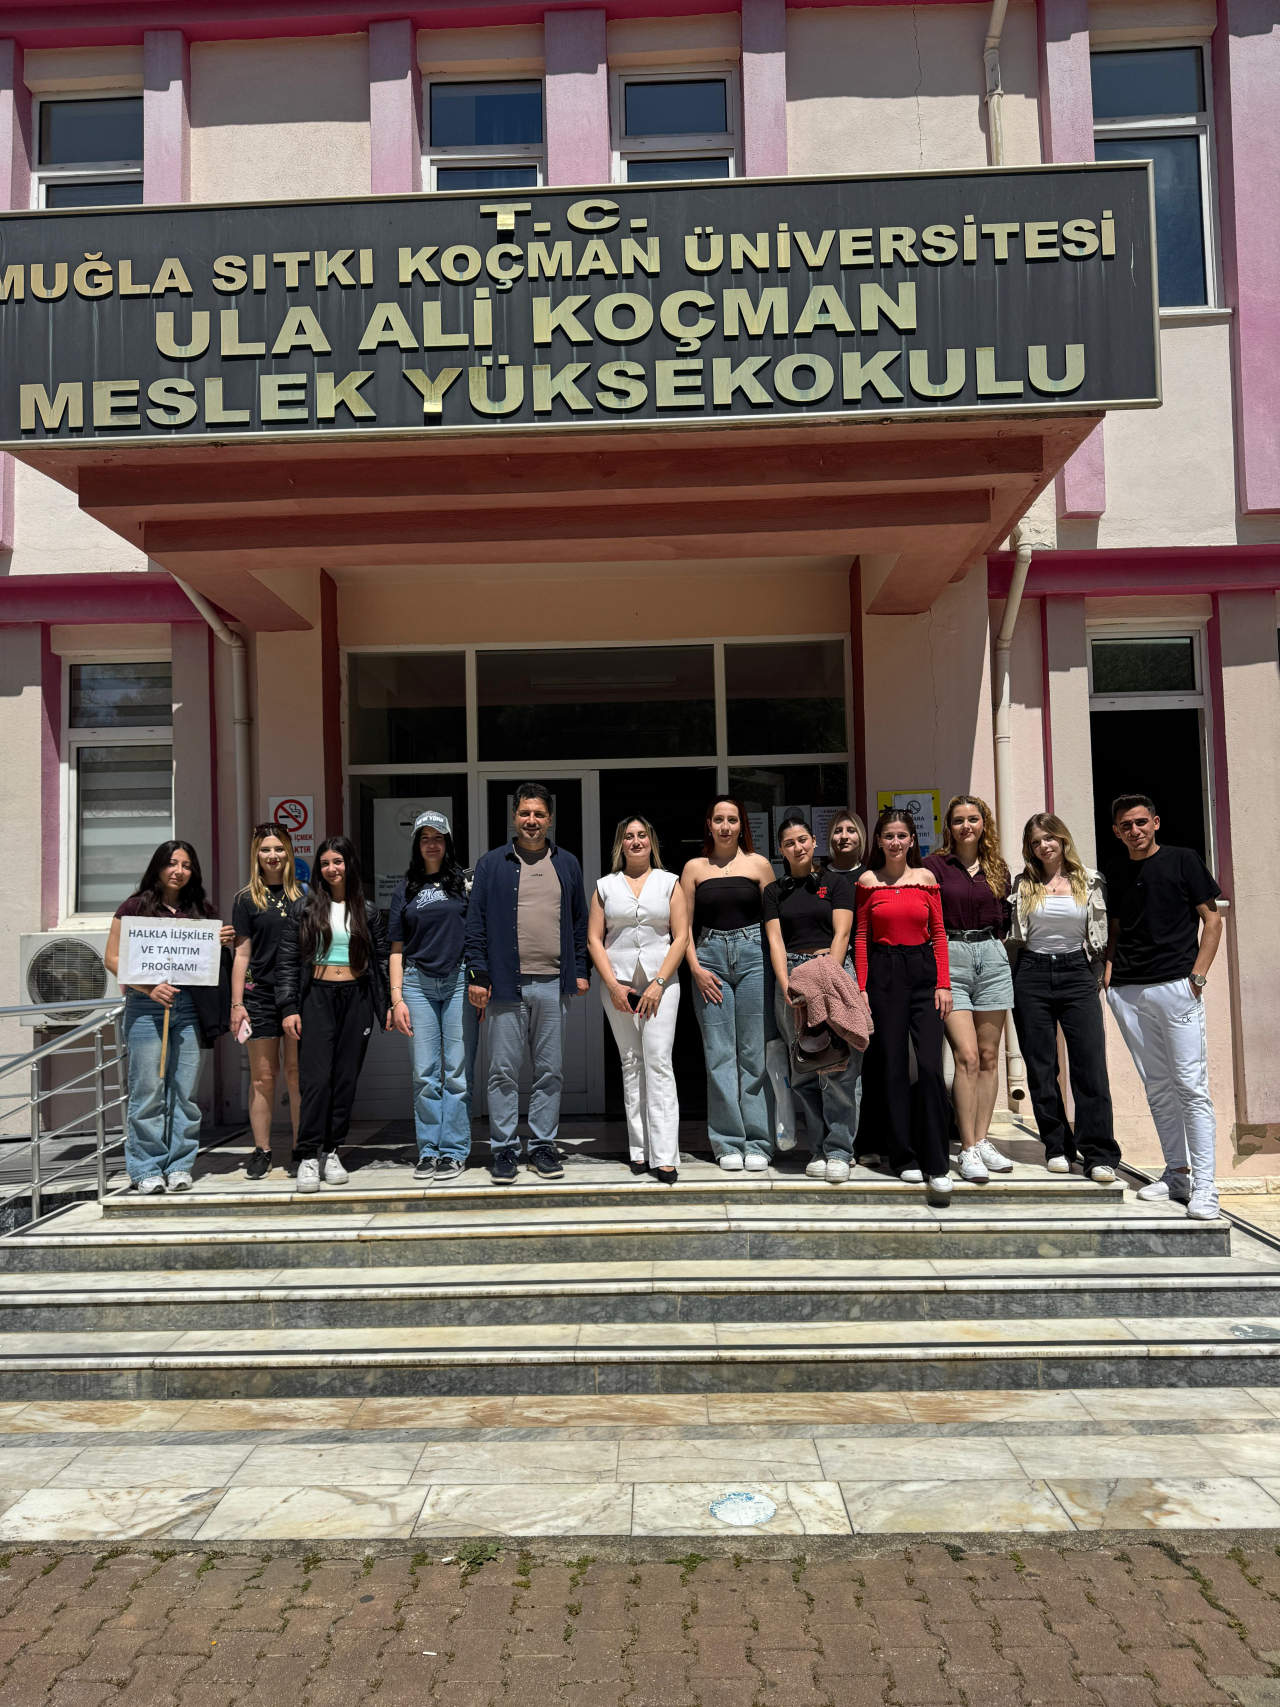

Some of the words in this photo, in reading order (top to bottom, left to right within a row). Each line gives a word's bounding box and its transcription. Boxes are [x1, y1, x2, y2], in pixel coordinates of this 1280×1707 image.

[480, 199, 648, 230] T.C.
[0, 253, 193, 299] MUĞLA
[212, 248, 374, 293] SITKI
[399, 236, 661, 290] KOÇMAN
[684, 209, 1117, 272] ÜNİVERSİTESİ
[155, 305, 333, 358] ULA
[358, 287, 493, 351] ALİ
[532, 281, 918, 352] KOÇMAN
[20, 370, 377, 430] MESLEK
[402, 343, 1086, 415] YÜKSEKOKULU
[294, 833, 314, 842] İÇMEK
[293, 846, 312, 854] KTIR
[128, 929, 168, 939] HALKLA
[170, 929, 214, 942] İLİŞKİLER
[141, 945, 154, 954] VE
[157, 946, 200, 955] TANITIM
[141, 962, 198, 972] PROGRAMI
